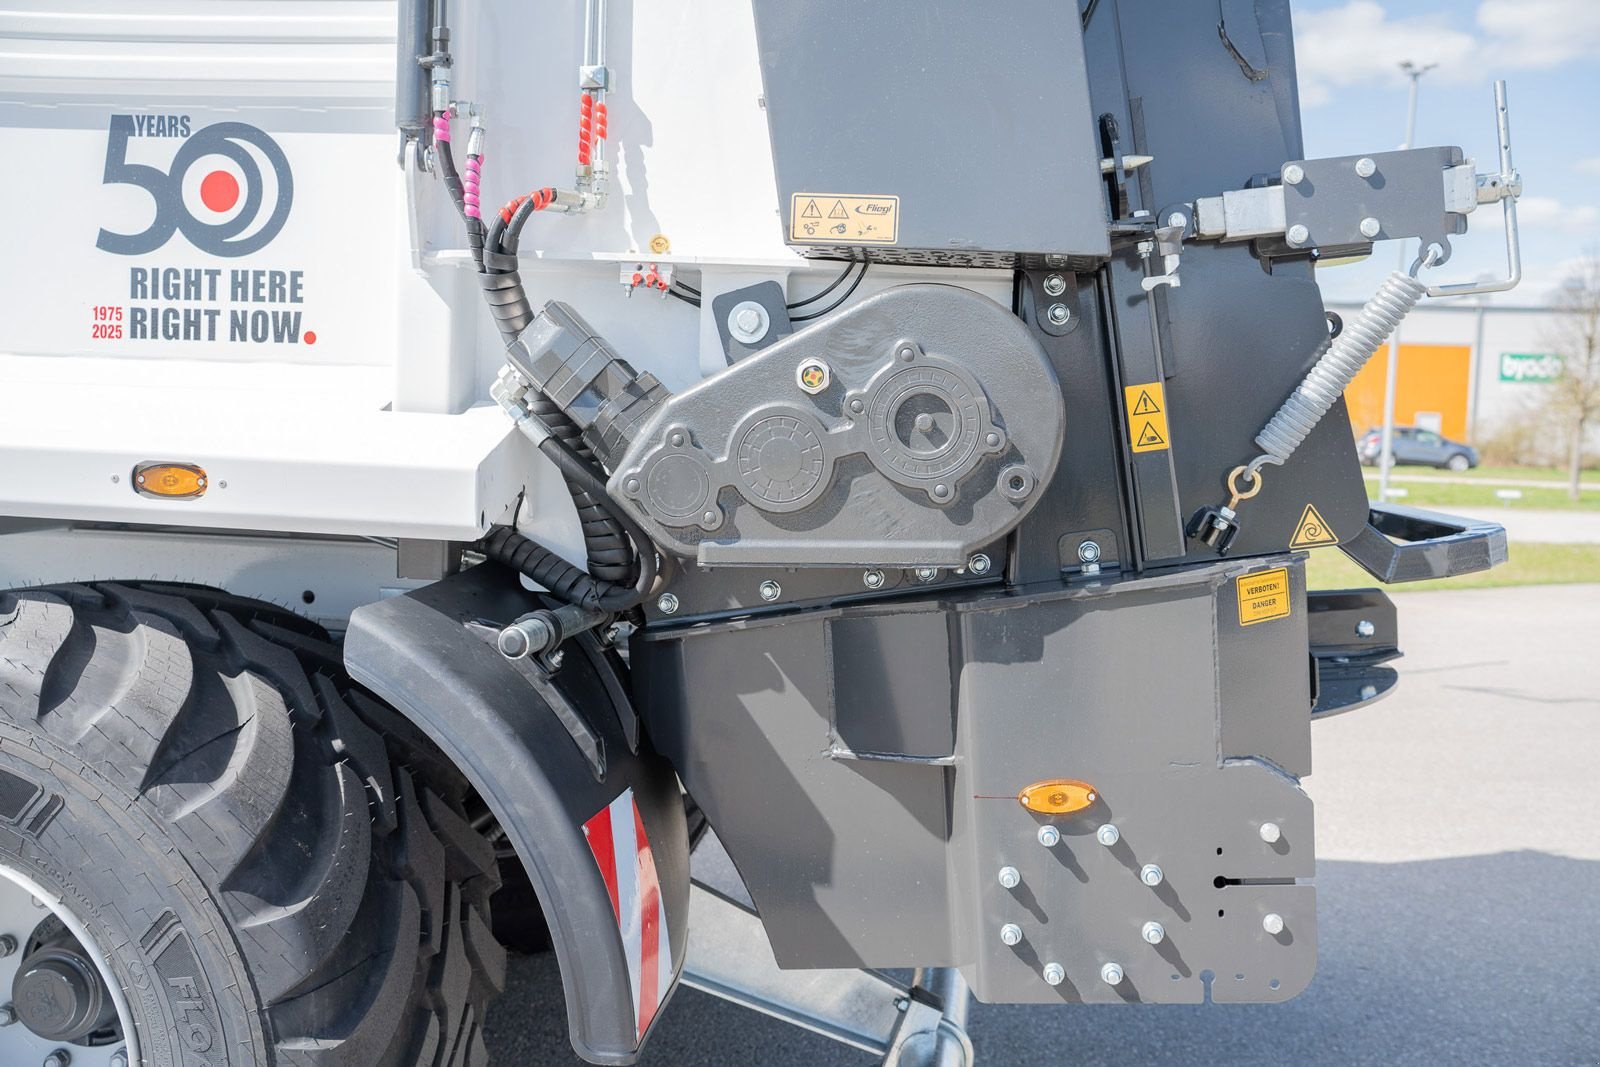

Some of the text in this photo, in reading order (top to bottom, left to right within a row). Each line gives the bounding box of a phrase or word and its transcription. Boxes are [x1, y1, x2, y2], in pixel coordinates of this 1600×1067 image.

[135, 114, 191, 138] YEARS
[96, 114, 294, 258] 50
[130, 267, 304, 304] RIGHT HERE
[93, 306, 123, 321] 1975
[130, 307, 317, 345] RIGHT NOW.
[92, 324, 123, 339] 2025
[1252, 598, 1277, 609] DANGER
[168, 976, 214, 1067] FLO
